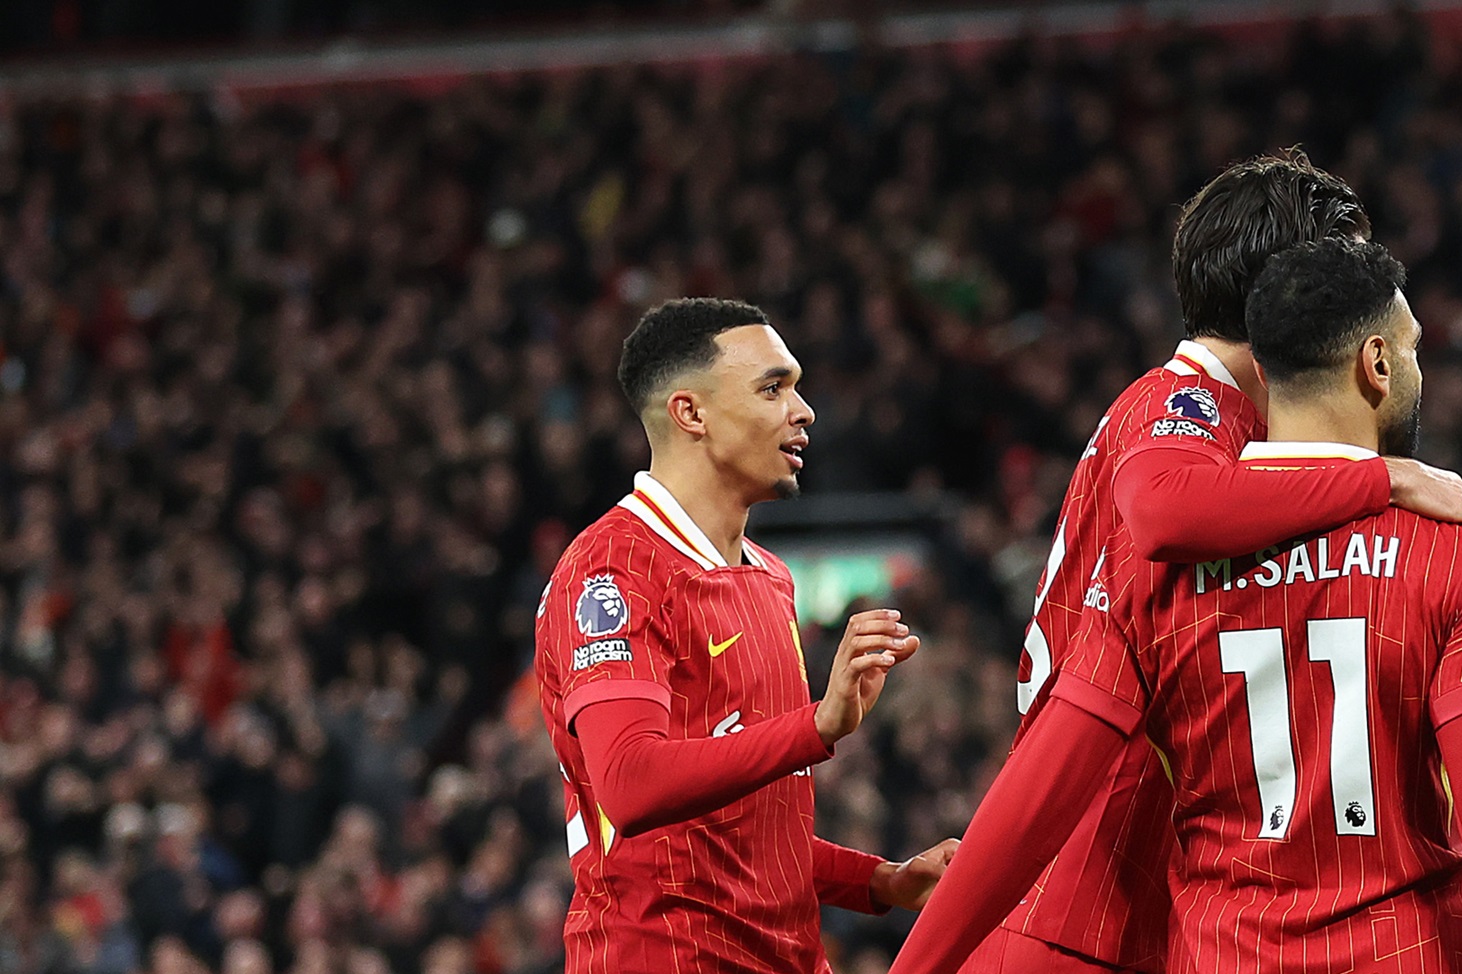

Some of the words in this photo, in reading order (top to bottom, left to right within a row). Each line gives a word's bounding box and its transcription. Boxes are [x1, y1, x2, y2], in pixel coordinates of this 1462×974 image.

[1153, 420, 1175, 430] No
[1176, 420, 1213, 440] room
[573, 646, 589, 659] No
[589, 640, 626, 654] room
[590, 650, 633, 665] racism
[1218, 617, 1376, 839] 11
